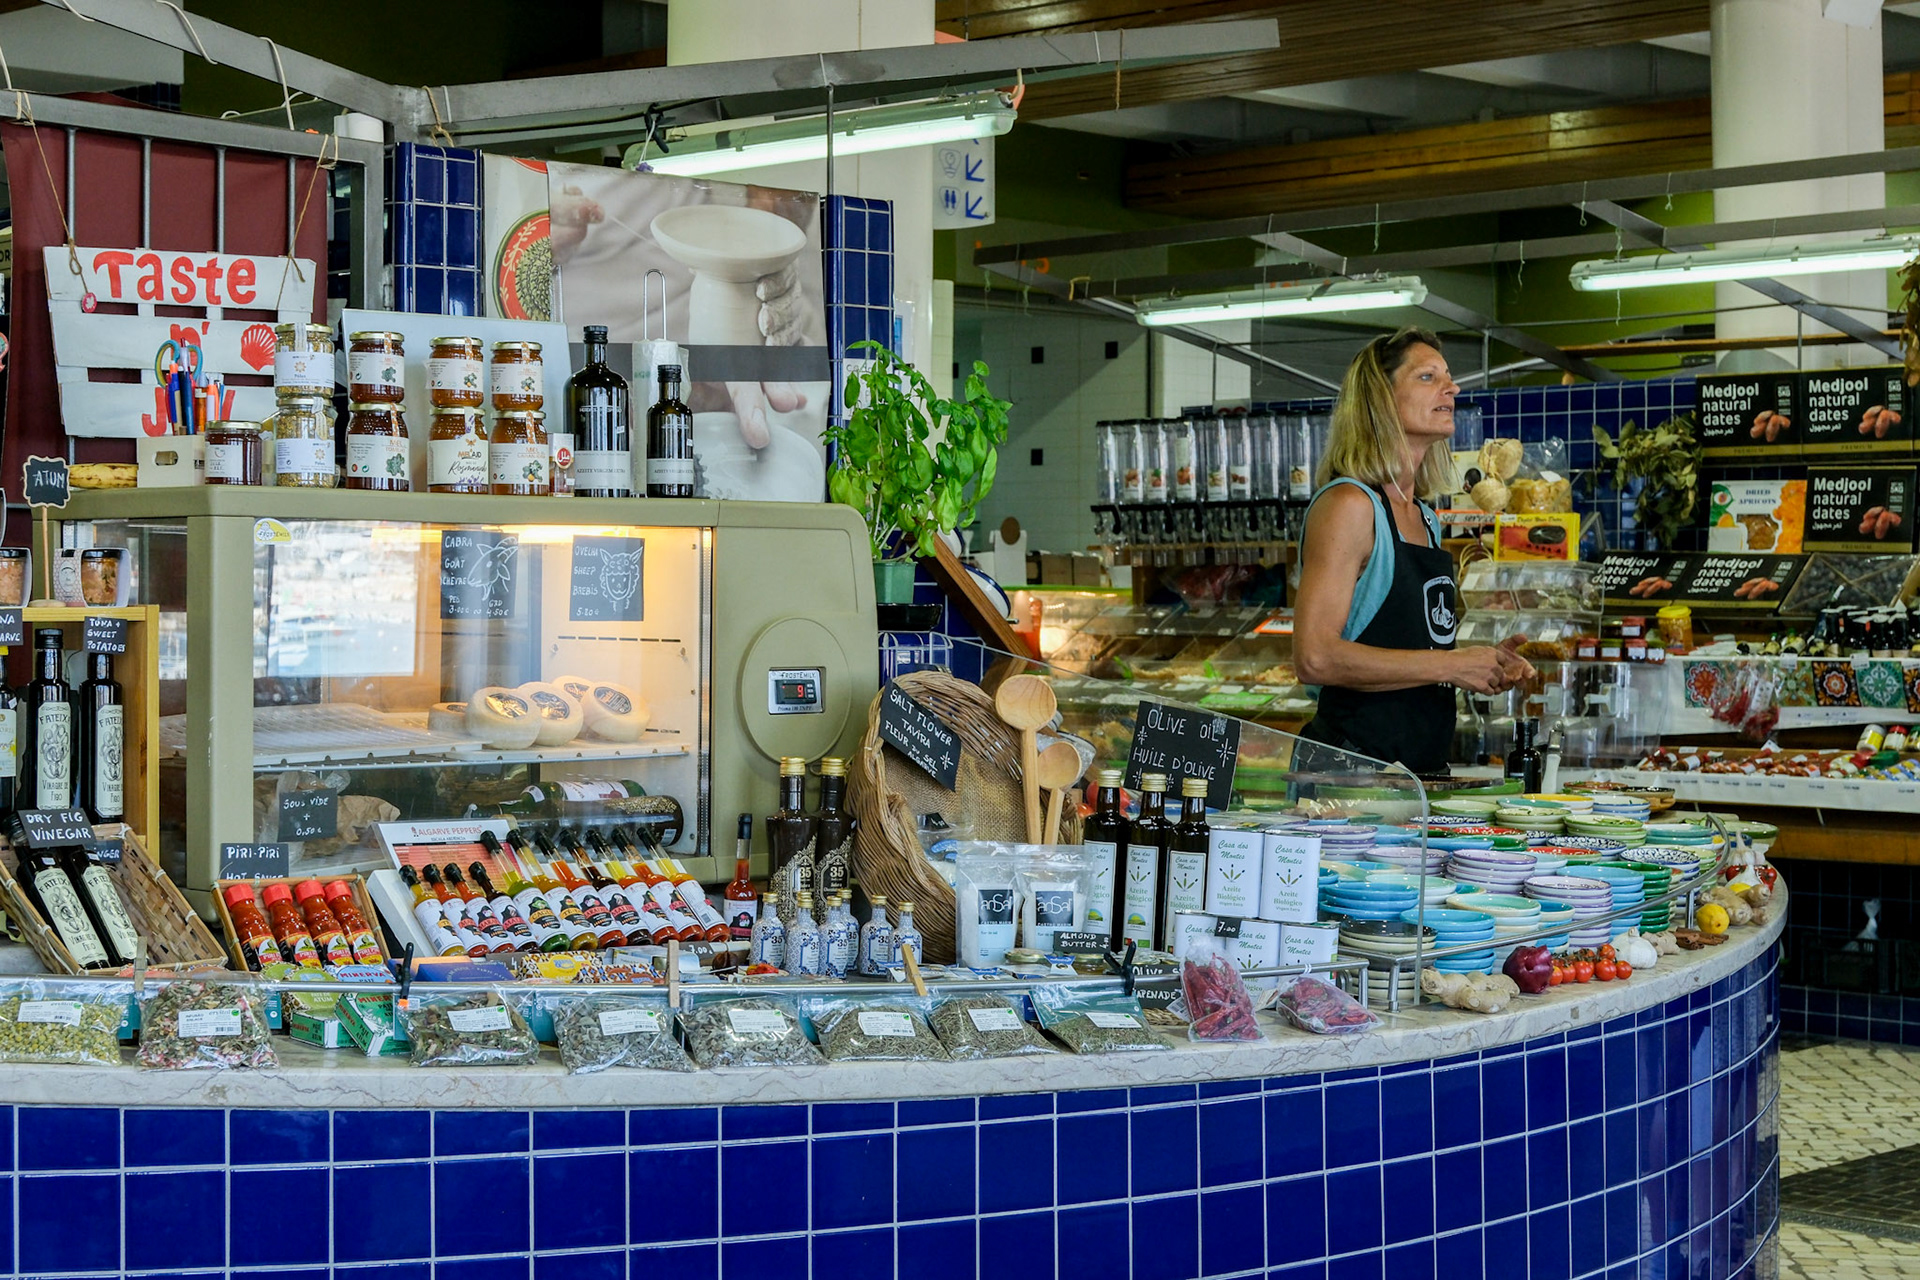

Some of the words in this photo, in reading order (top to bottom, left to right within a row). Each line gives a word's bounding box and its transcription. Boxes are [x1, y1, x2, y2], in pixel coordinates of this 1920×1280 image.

[93, 251, 257, 305] Taste
[1702, 382, 1760, 400] Medjool
[1808, 376, 1868, 394] Medjool
[1702, 397, 1751, 412] natural
[1809, 392, 1860, 408] natural
[1702, 413, 1741, 426] dates
[1809, 408, 1850, 422] dates
[32, 470, 65, 488] ATUM
[1814, 477, 1872, 494] Medjool
[1813, 492, 1862, 506] natural
[1812, 506, 1850, 520] dates
[444, 536, 473, 548] CABRA
[574, 546, 598, 556] OVELHA
[444, 558, 465, 568] GOAT
[1602, 556, 1660, 568] Medjool
[1702, 558, 1764, 570] Medjool
[574, 566, 596, 576] SHEEP
[1598, 564, 1646, 576] natural
[1698, 567, 1750, 578] natural
[1592, 574, 1629, 585] dates
[1692, 576, 1732, 588] dates
[572, 584, 598, 596] BREBIS
[90, 618, 112, 628] TUNA
[87, 628, 118, 638] SWEET
[87, 640, 126, 652] POTATOES
[797, 684, 804, 698] 9
[890, 689, 914, 714] SALT
[916, 712, 952, 746] FLOWER
[1147, 708, 1186, 736] OLIVE
[1200, 724, 1219, 742] OIL
[902, 718, 932, 748] TAVIRA
[884, 720, 910, 747] FLEUR
[922, 754, 938, 772] SEL
[907, 751, 937, 778] ALGARVE
[1132, 746, 1166, 768] HUILE
[1172, 755, 1216, 780] D'OLIVE
[310, 796, 330, 806] VIDE
[25, 814, 52, 824] DRY
[60, 812, 84, 824] FIG
[32, 827, 92, 841] VINEGAR
[418, 828, 450, 836] ALGARVE
[451, 826, 482, 834] PEPPERS
[1218, 840, 1236, 849] Casa
[1237, 841, 1248, 850] dos
[1274, 844, 1292, 854] Casa
[1294, 846, 1306, 854] dos
[226, 845, 280, 859] PIRI-PIRI
[1220, 850, 1246, 860] Montes
[1277, 856, 1302, 864] Montes
[830, 866, 844, 878] 35
[1184, 924, 1202, 934] Casa
[771, 936, 783, 944] 35
[1254, 932, 1266, 940] dos
[1284, 934, 1302, 944] Casa
[1304, 937, 1315, 946] dos
[837, 938, 848, 947] 35
[1238, 940, 1262, 950] Montes
[1287, 946, 1312, 956] Montes
